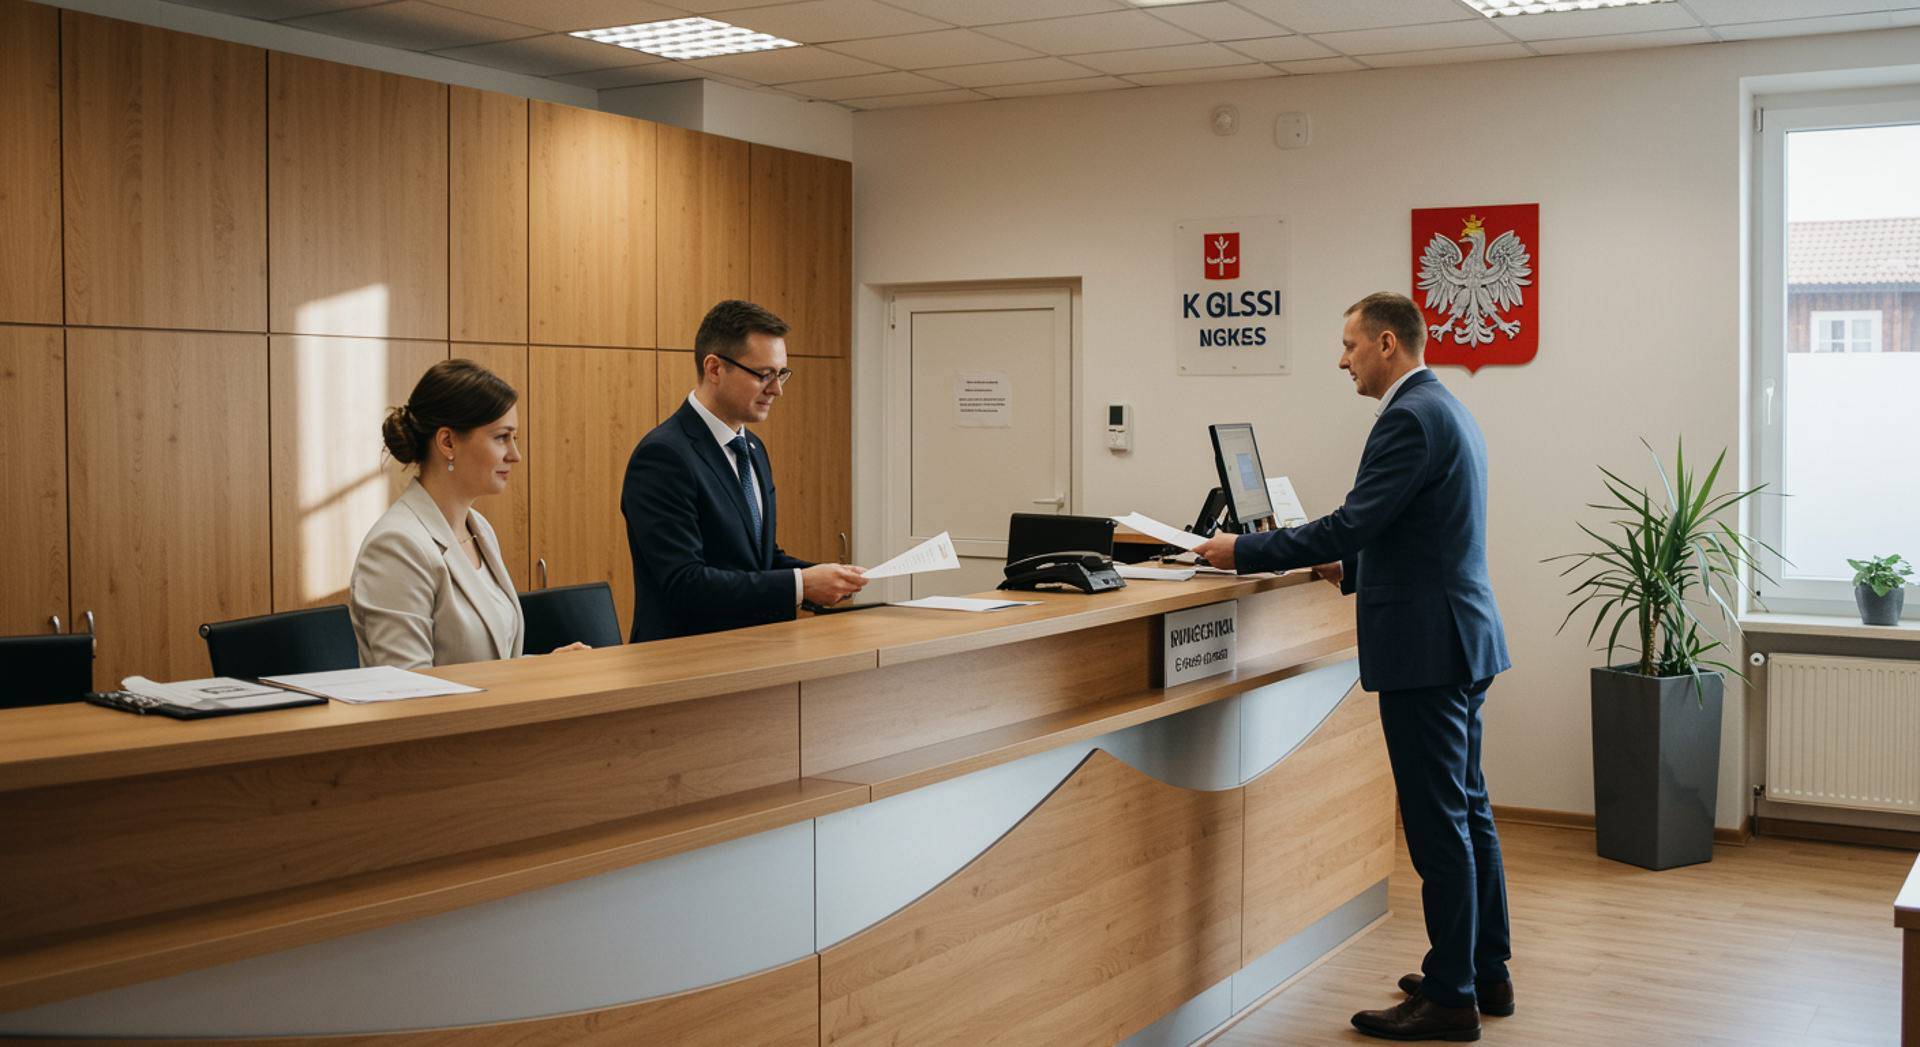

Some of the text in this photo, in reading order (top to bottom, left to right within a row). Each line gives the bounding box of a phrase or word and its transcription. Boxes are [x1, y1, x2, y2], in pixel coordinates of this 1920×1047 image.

[1183, 290, 1280, 318] K GLSSI
[1200, 327, 1266, 347] NGKES
